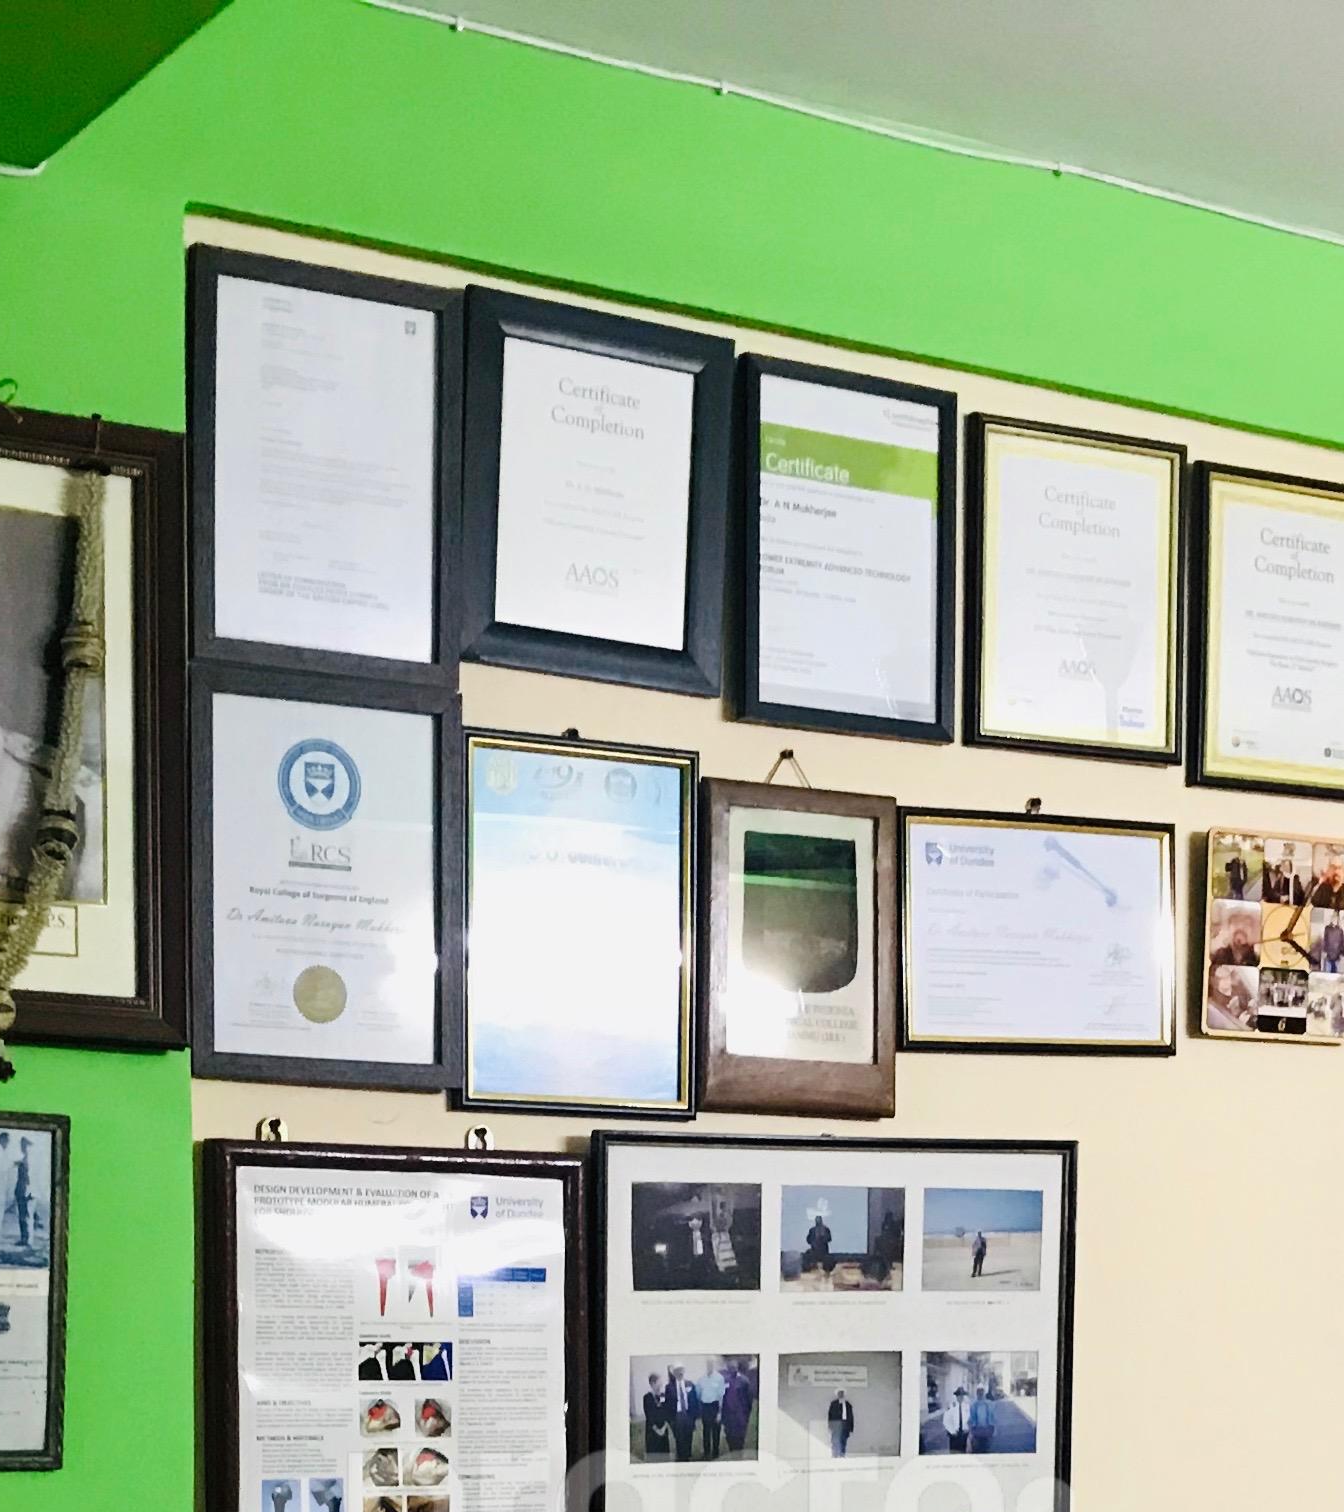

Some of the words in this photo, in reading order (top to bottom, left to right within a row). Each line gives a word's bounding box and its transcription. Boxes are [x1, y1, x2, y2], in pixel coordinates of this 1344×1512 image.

[559, 377, 641, 411] Certificate
[551, 405, 645, 441] Completion
[765, 452, 851, 486] Certificate
[1044, 485, 1117, 512] Certificate
[1038, 511, 1121, 540] Completion
[1260, 527, 1331, 555] Certificate
[565, 563, 620, 588] AAOS
[1254, 555, 1335, 585] Completion
[1272, 685, 1313, 705] AAOS
[311, 842, 352, 864] RCS
[949, 844, 995, 857] University
[253, 1184, 287, 1195] DESIGN
[289, 1185, 354, 1197] DEVELOPMENT
[420, 1190, 431, 1200] OF
[495, 1196, 544, 1210] University
[495, 1208, 505, 1218] of
[506, 1208, 544, 1219] Dundee
